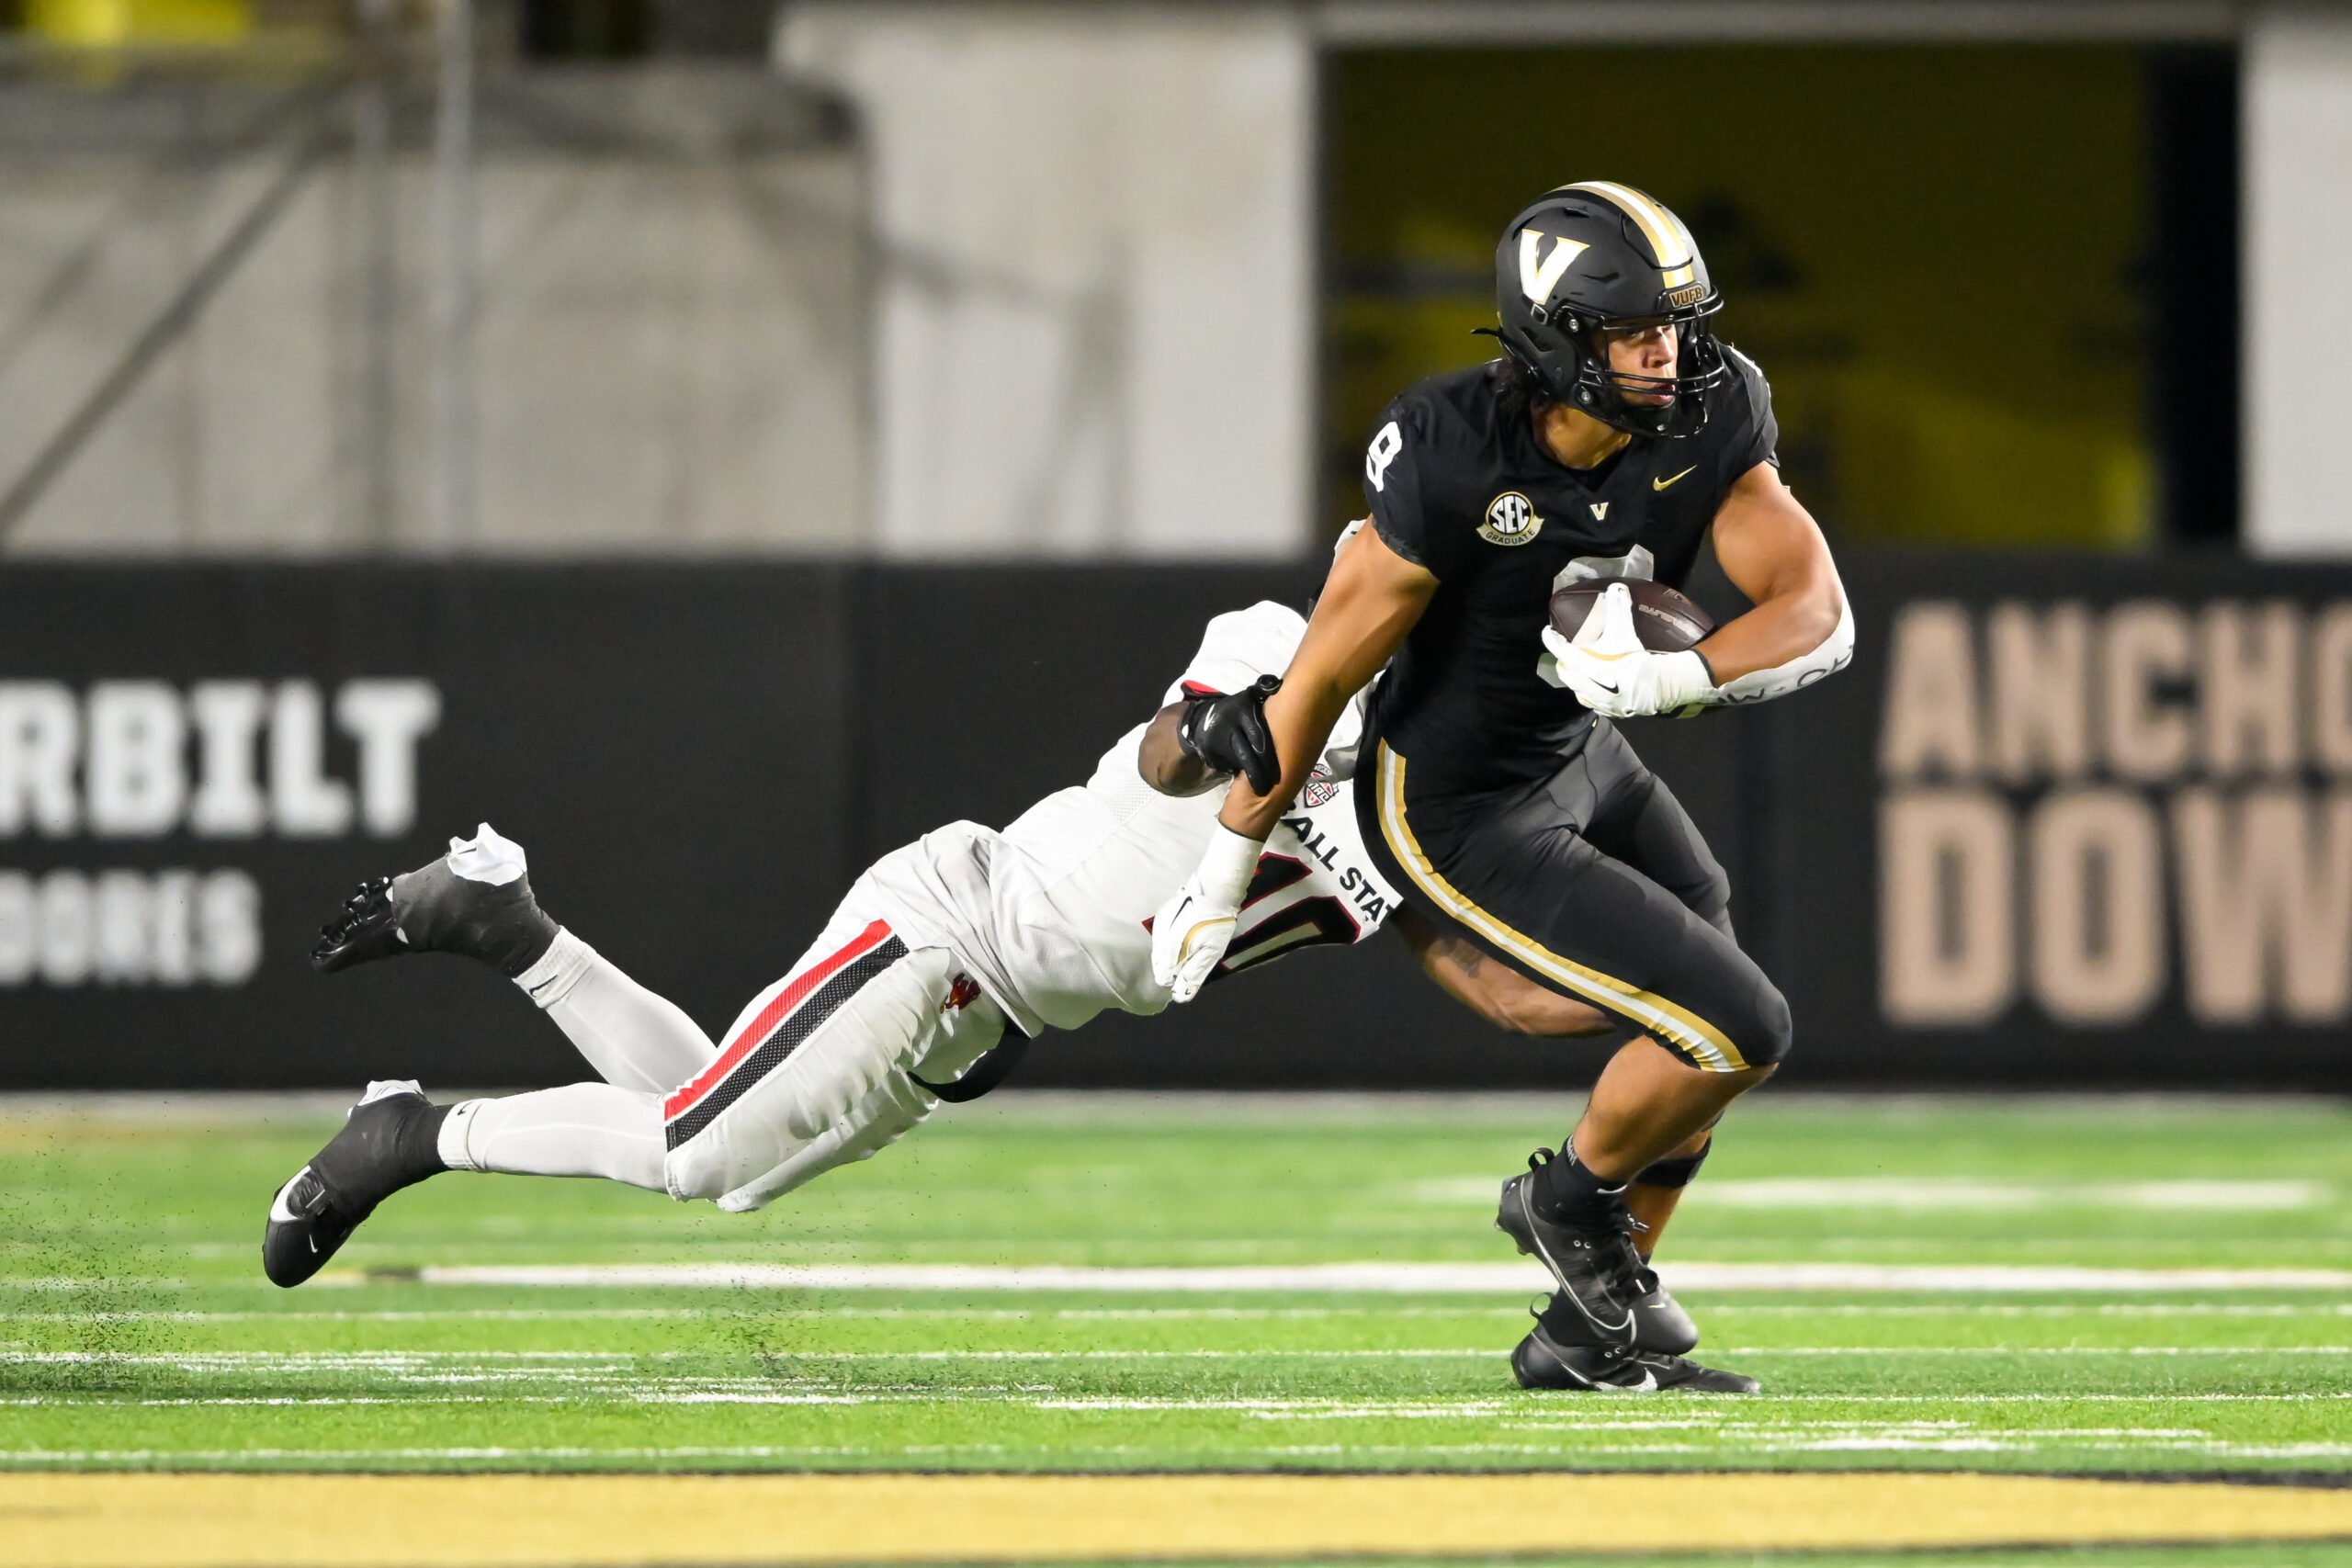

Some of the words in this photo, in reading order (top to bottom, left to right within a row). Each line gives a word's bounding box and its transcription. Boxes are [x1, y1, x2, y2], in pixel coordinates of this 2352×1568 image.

[1520, 228, 1591, 306] V
[1669, 285, 1704, 308] VUFB
[1489, 495, 1530, 534] SEC
[1589, 502, 1609, 521] V
[1486, 529, 1535, 545] GRADUATE
[1281, 799, 1340, 872] ALL
[1882, 790, 2352, 1024] DOW
